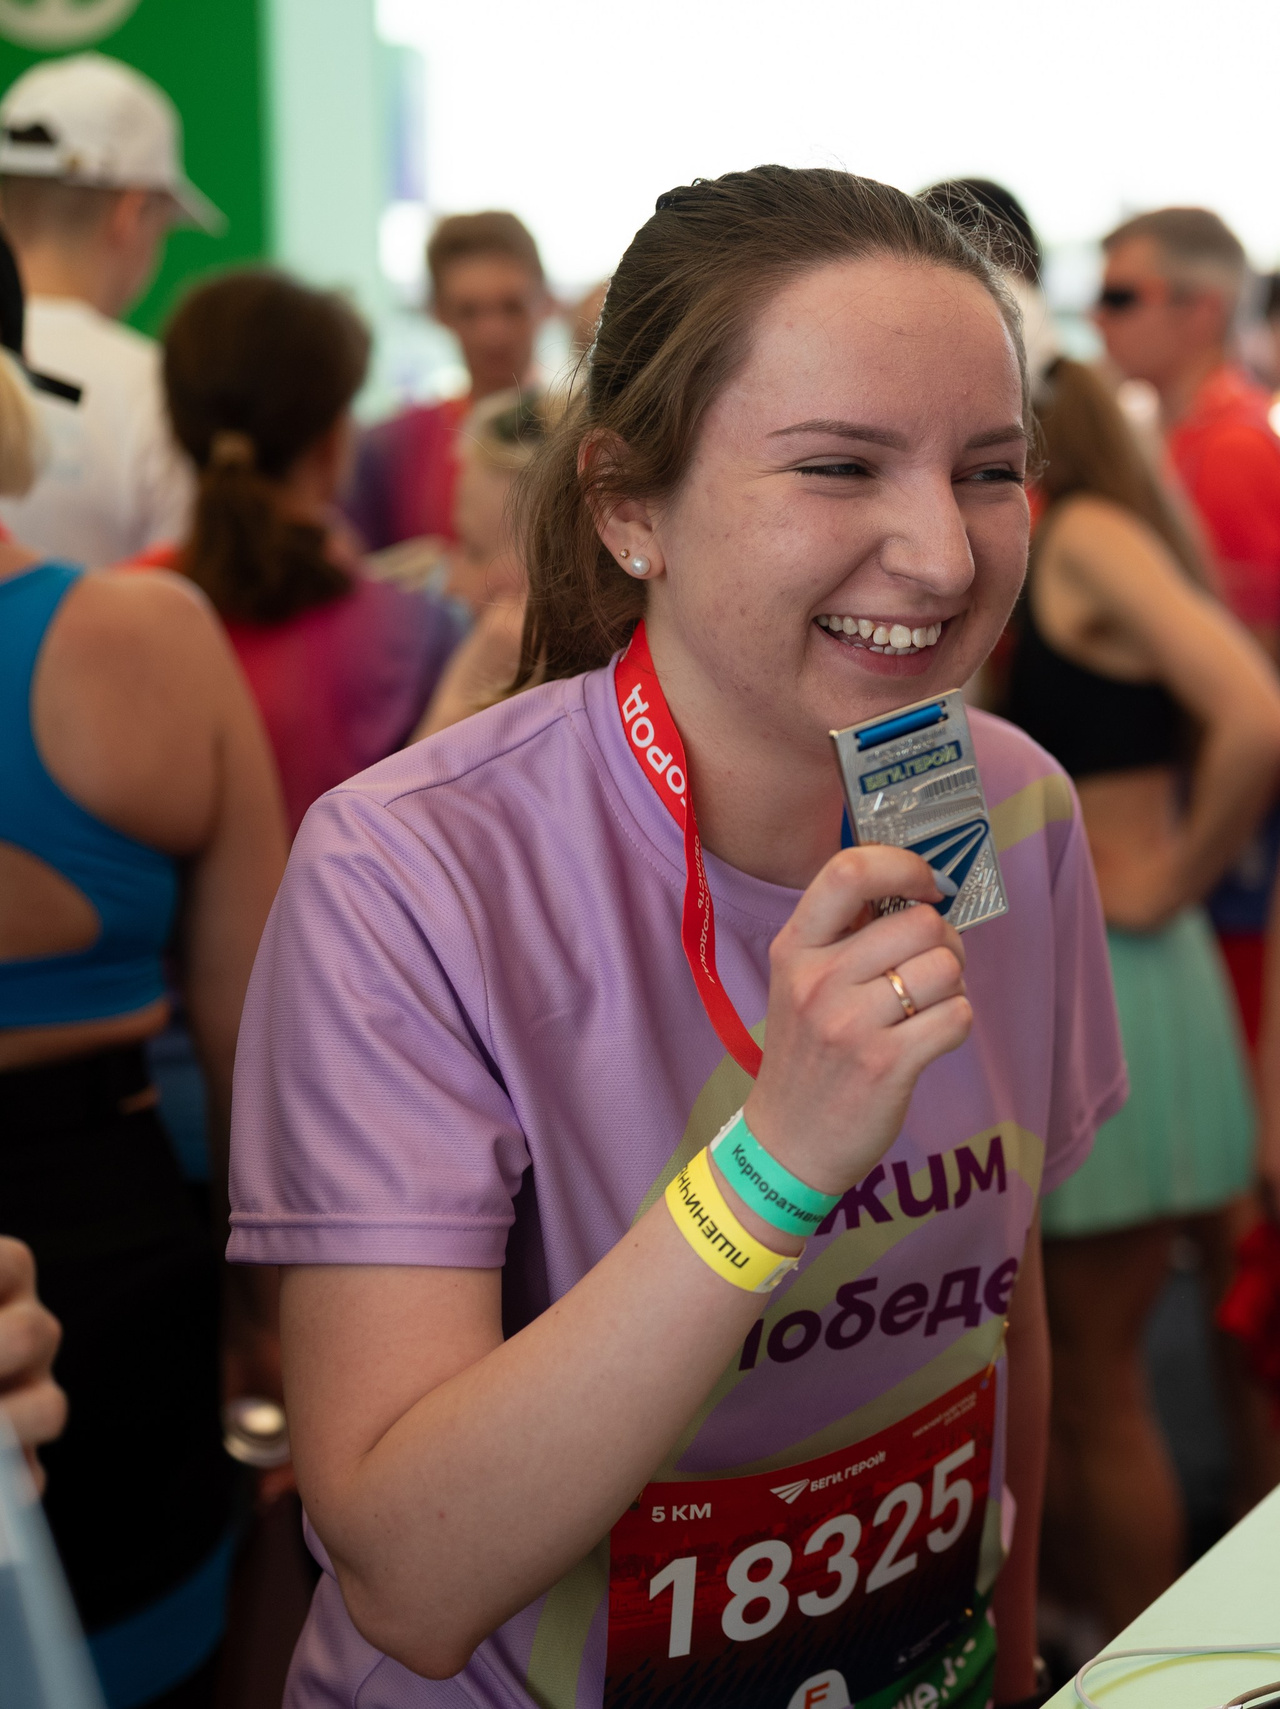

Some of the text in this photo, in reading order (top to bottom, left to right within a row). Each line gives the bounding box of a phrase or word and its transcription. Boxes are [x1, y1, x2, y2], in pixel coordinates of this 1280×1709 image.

[621, 682, 686, 807] ОРОД
[814, 1135, 1007, 1237] жим
[649, 1439, 976, 1659] 18325
[651, 1505, 666, 1523] 5
